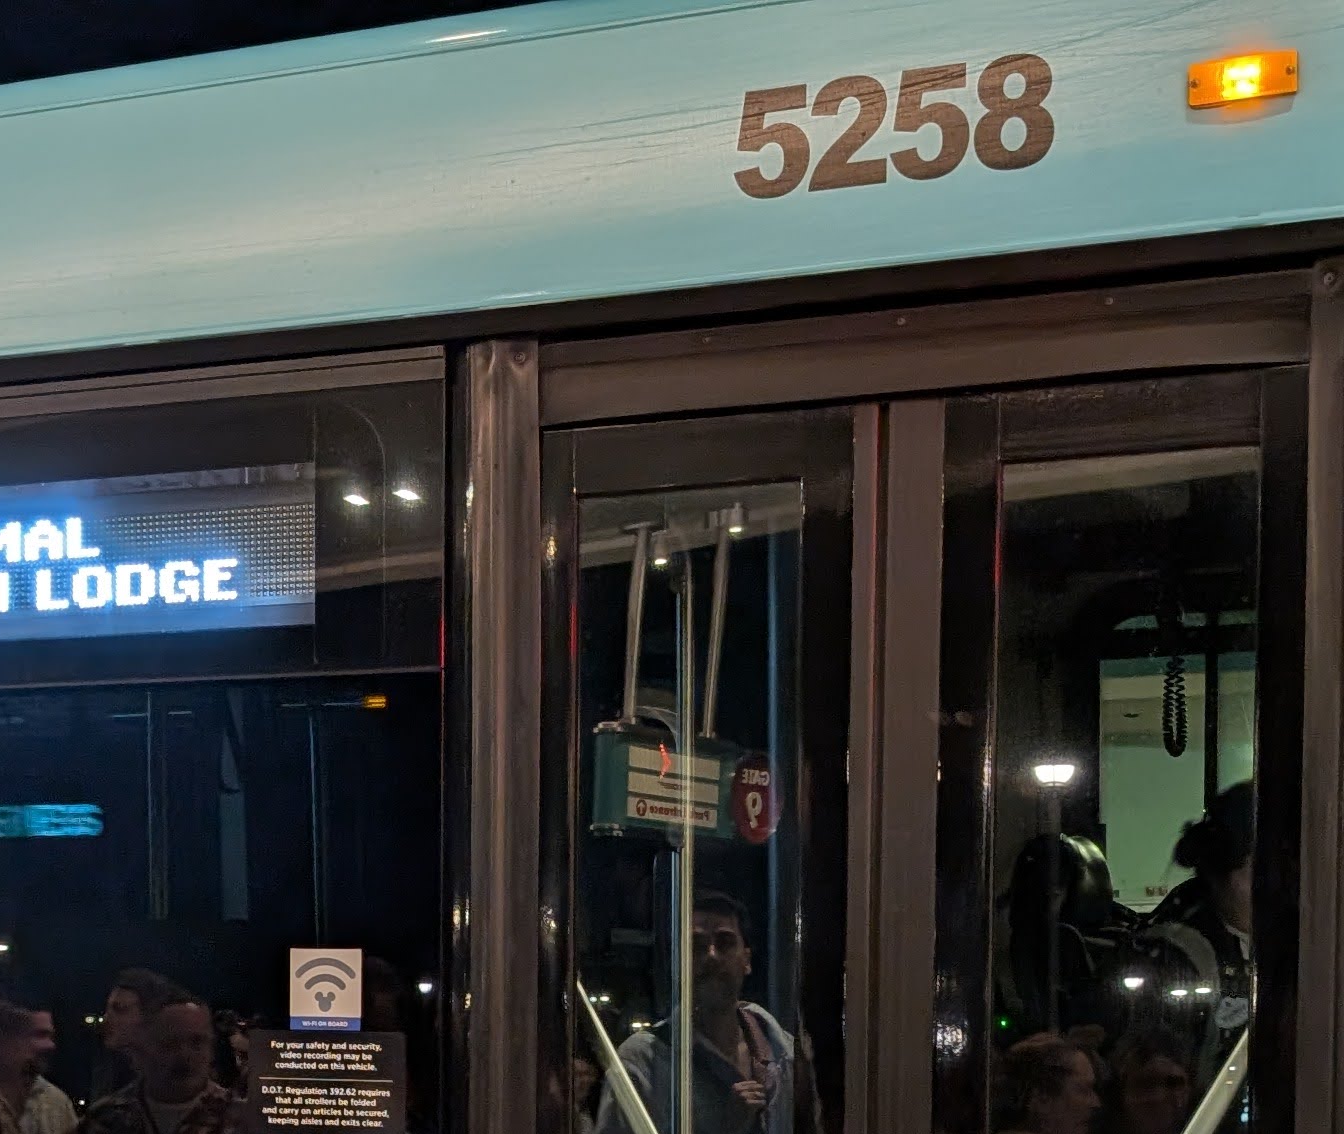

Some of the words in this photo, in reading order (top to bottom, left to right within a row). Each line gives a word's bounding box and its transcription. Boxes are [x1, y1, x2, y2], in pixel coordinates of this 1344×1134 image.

[733, 53, 1055, 199] 5258
[35, 558, 239, 611] LODGE
[306, 1041, 329, 1051] safety
[304, 1052, 342, 1061] recording
[261, 1086, 284, 1094] D.O.T.
[285, 1086, 328, 1096] Regulation
[330, 1088, 356, 1096] 392.62
[358, 1089, 391, 1098] requires
[338, 1098, 348, 1106] be
[350, 1098, 376, 1106] folded
[313, 1107, 342, 1116] articles
[344, 1108, 354, 1116] be
[268, 1116, 299, 1126] keeping
[324, 1118, 339, 1126] and
[341, 1118, 360, 1126] exits
